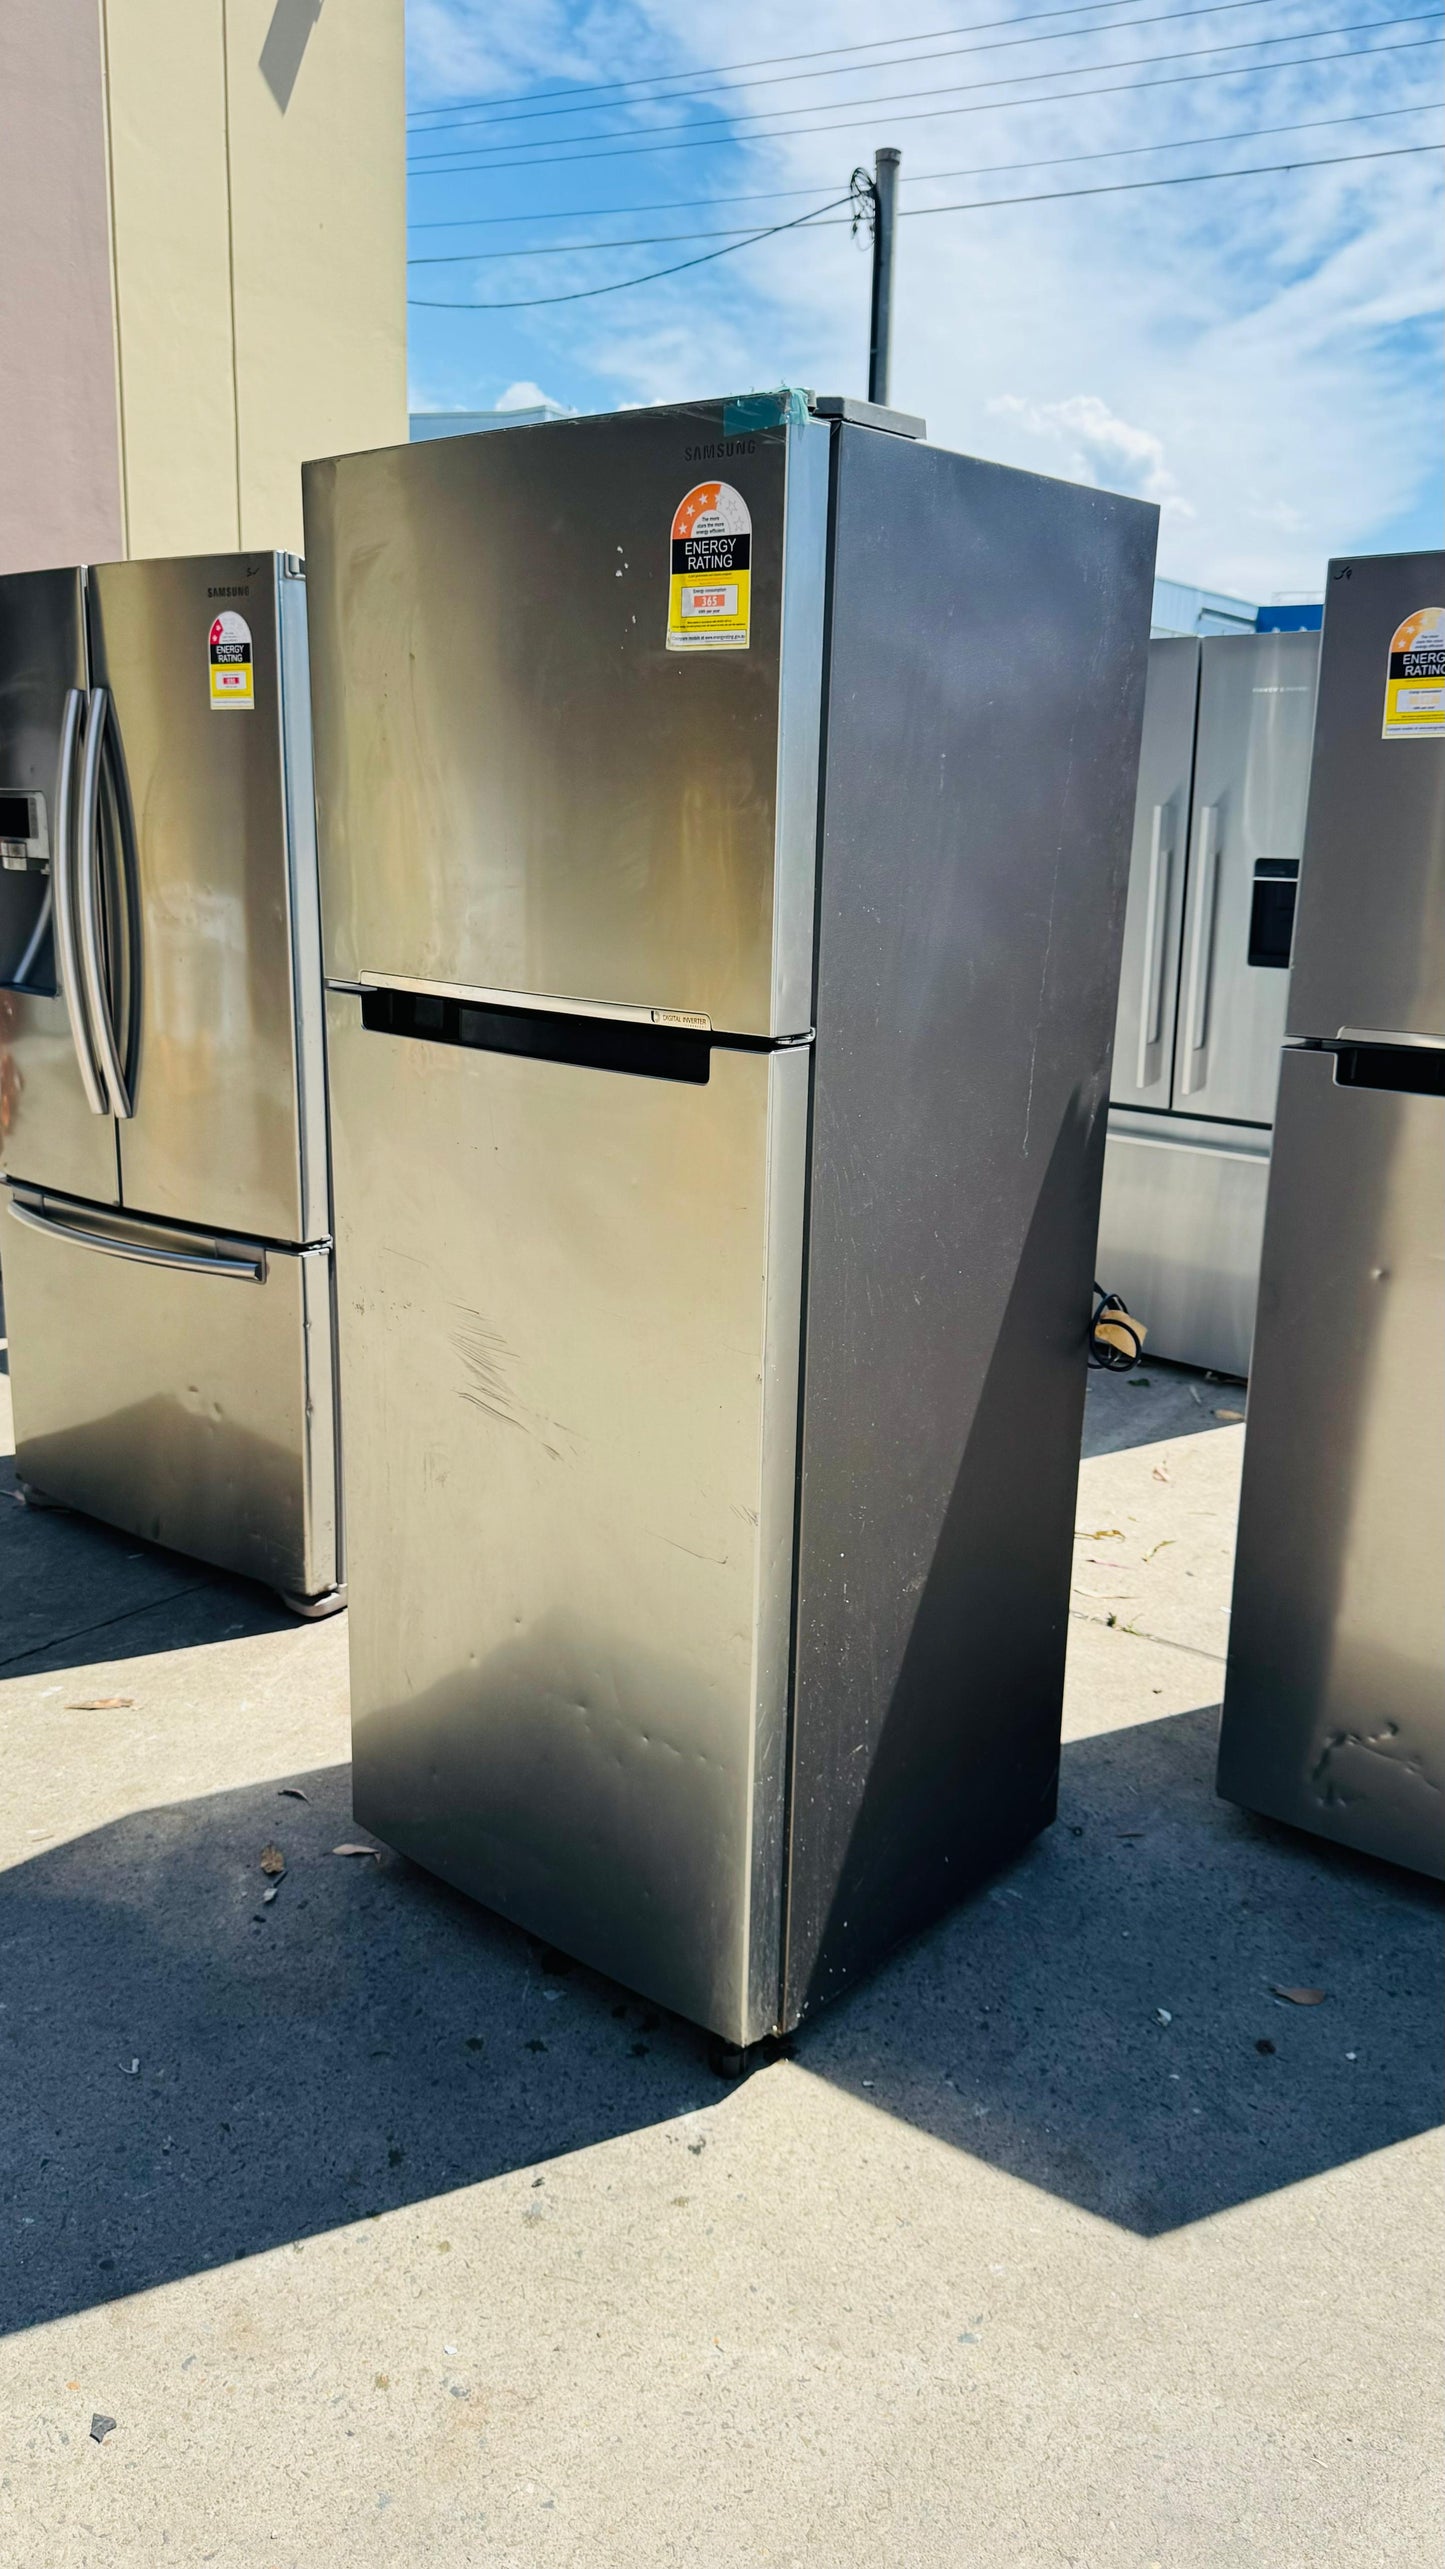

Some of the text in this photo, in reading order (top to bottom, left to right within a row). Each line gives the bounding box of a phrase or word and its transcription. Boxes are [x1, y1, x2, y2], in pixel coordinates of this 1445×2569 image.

[684, 440, 756, 461] SAMSUNG
[685, 538, 737, 555] ENERGY
[688, 554, 733, 570] RATING
[207, 586, 249, 598] SAMSUNG
[701, 596, 718, 606] 365
[216, 645, 244, 654] ENERGY
[218, 653, 243, 663] RATING
[1403, 652, 1445, 665] ENERG
